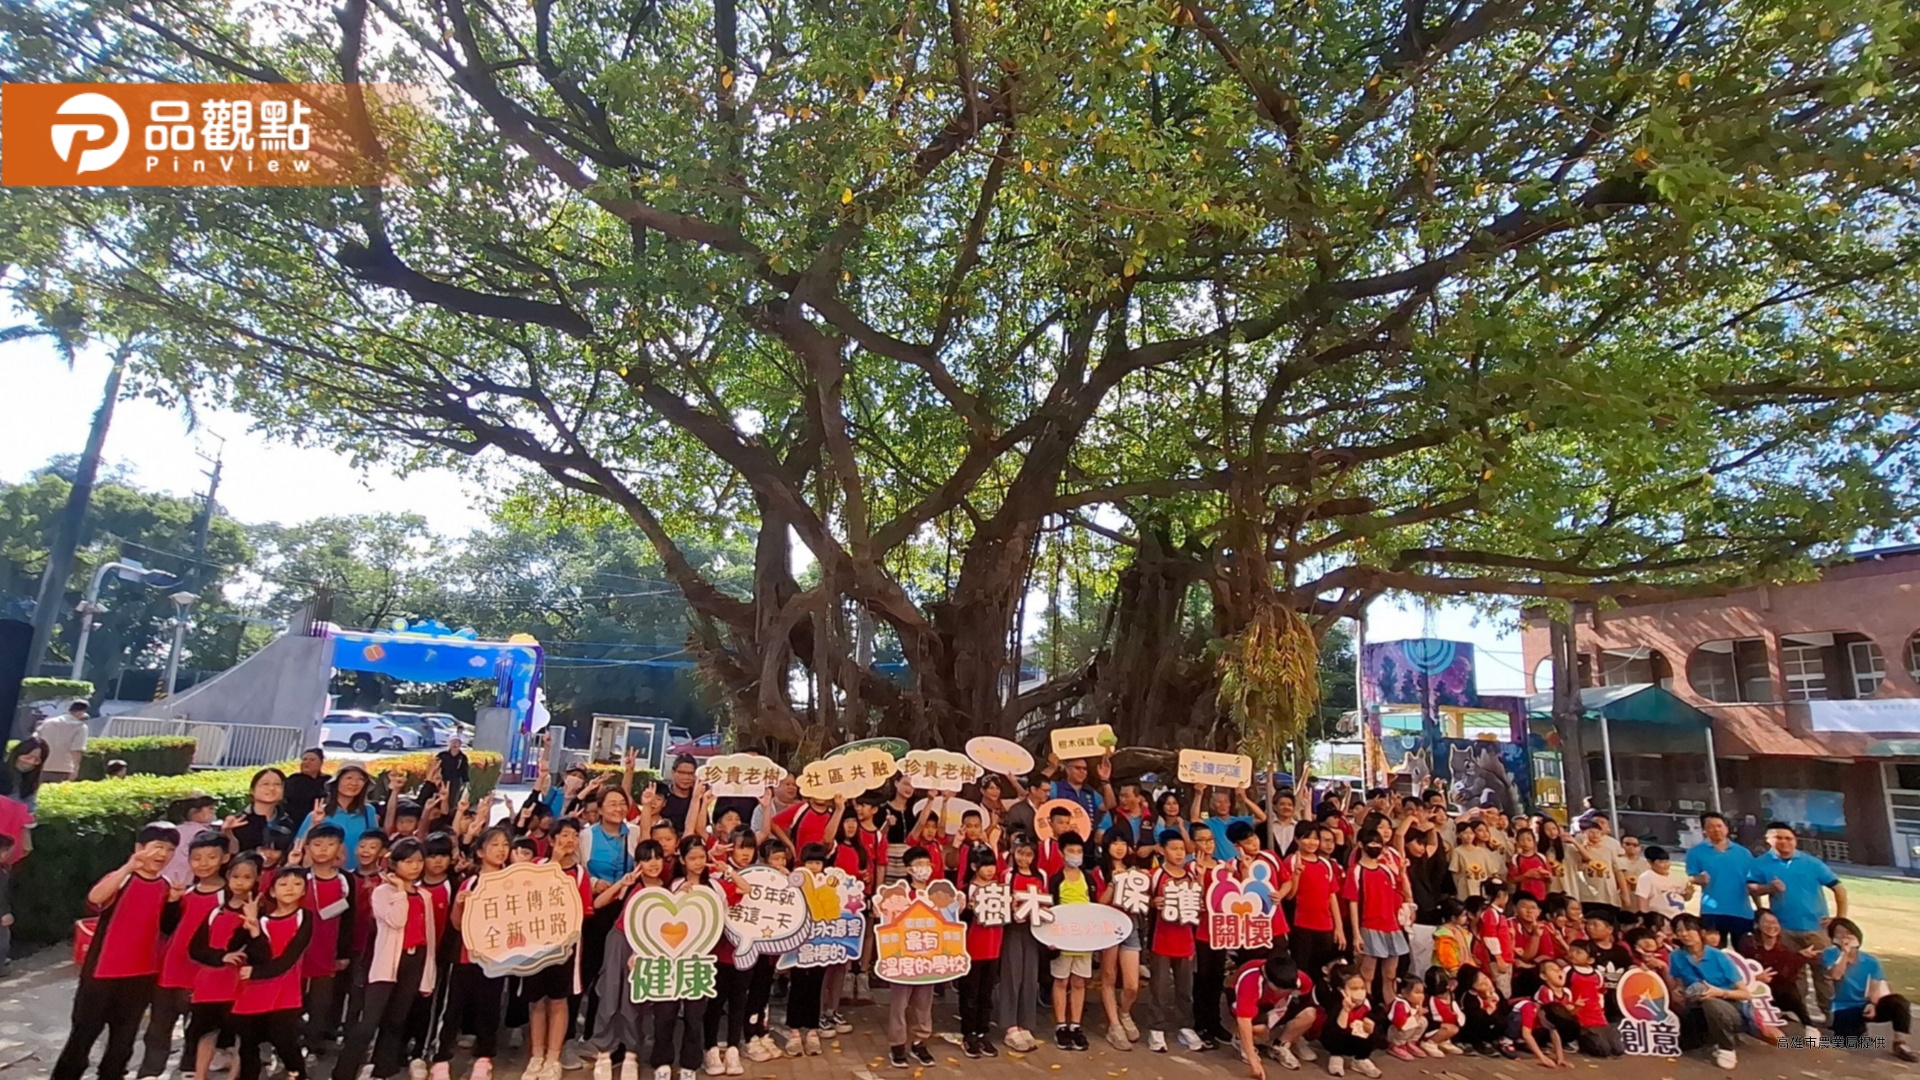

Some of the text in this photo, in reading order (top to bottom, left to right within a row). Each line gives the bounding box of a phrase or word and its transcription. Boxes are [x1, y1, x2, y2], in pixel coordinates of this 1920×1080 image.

[705, 765, 781, 787] 珍貴老樹
[805, 760, 890, 789] 社區共融
[903, 758, 978, 783] 珍貴老樹
[482, 886, 566, 921] 百年傳統
[727, 905, 793, 929] 等這一天
[484, 912, 567, 950] 全新中路
[905, 929, 940, 951] 最有
[1211, 914, 1273, 948] 關懷
[632, 954, 715, 1000] 健康
[1619, 1021, 1681, 1056] 創意
